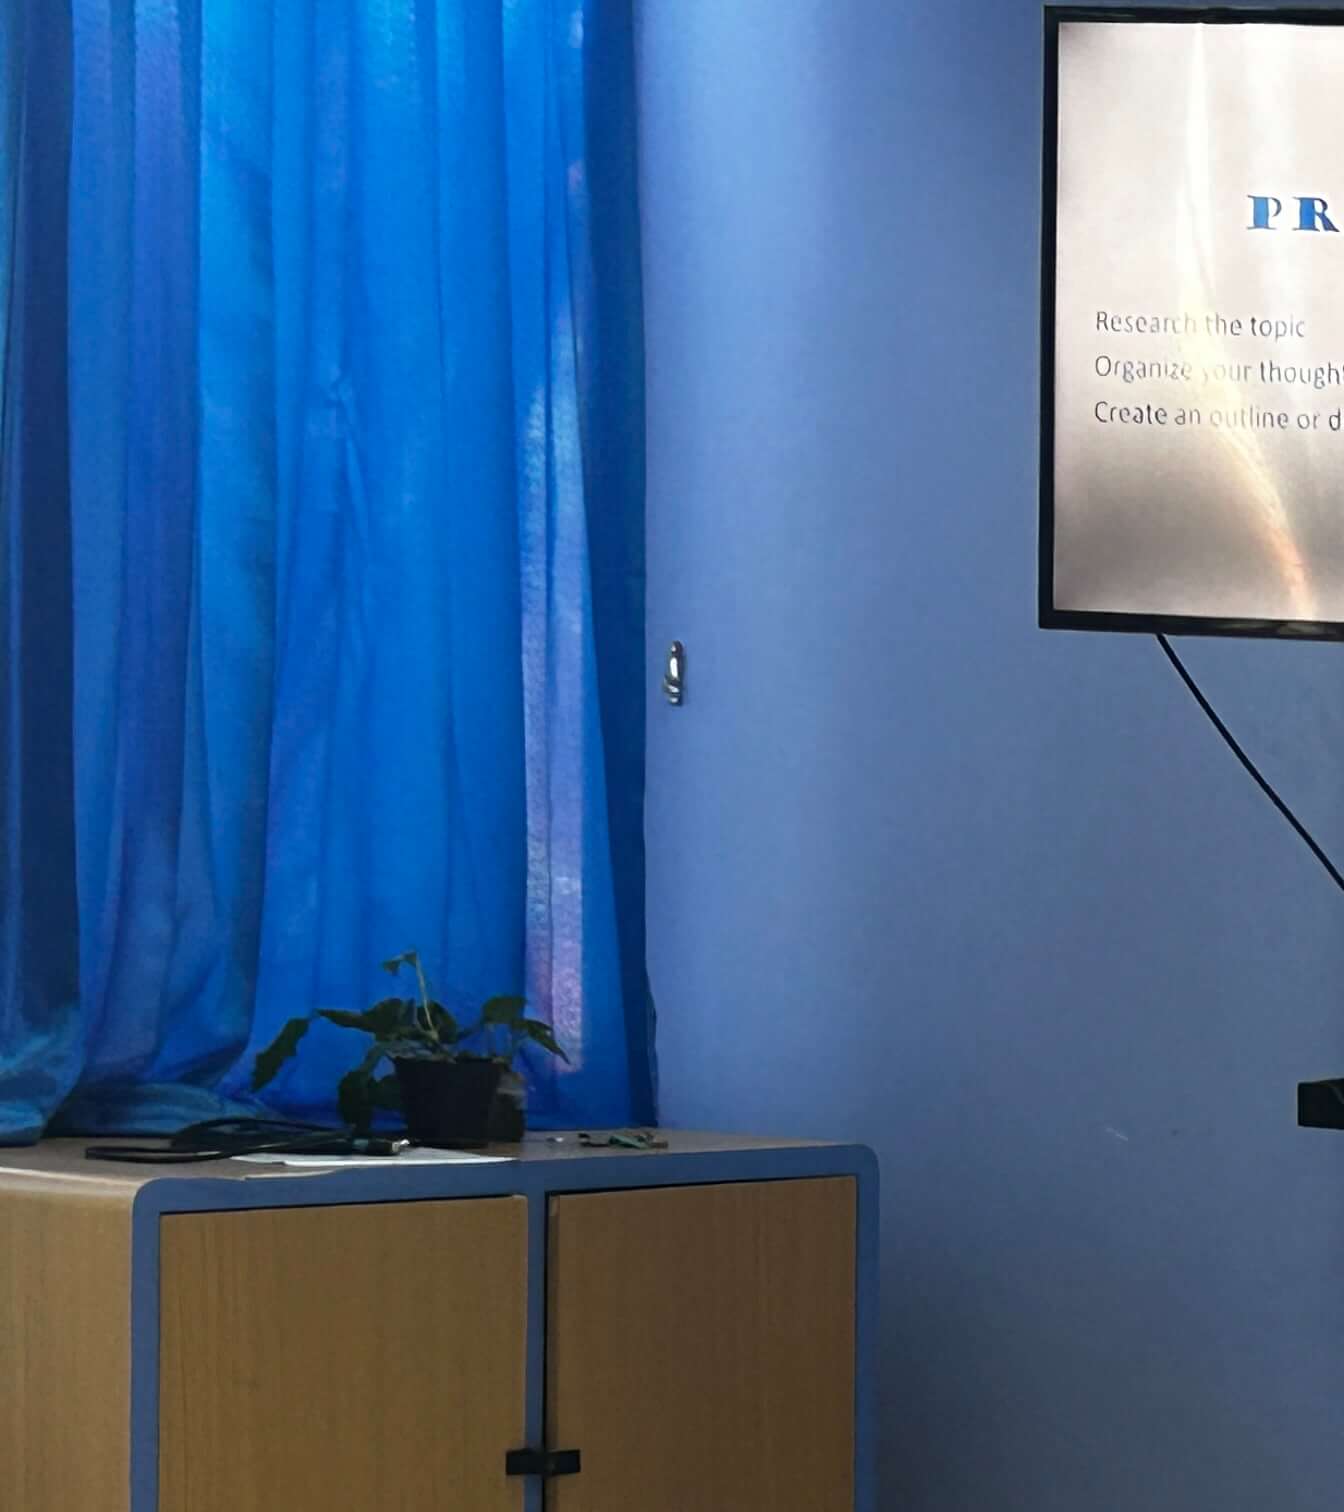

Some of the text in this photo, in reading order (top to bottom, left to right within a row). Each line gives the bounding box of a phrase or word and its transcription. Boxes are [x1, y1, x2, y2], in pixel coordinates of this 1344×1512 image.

[1095, 311, 1305, 342] Research the topic
[1095, 355, 1192, 383] Organize
[1202, 363, 1252, 387] your
[1095, 401, 1168, 425] Create
[1174, 407, 1201, 426] an
[1209, 405, 1289, 430] outline
[1296, 416, 1321, 430] or
